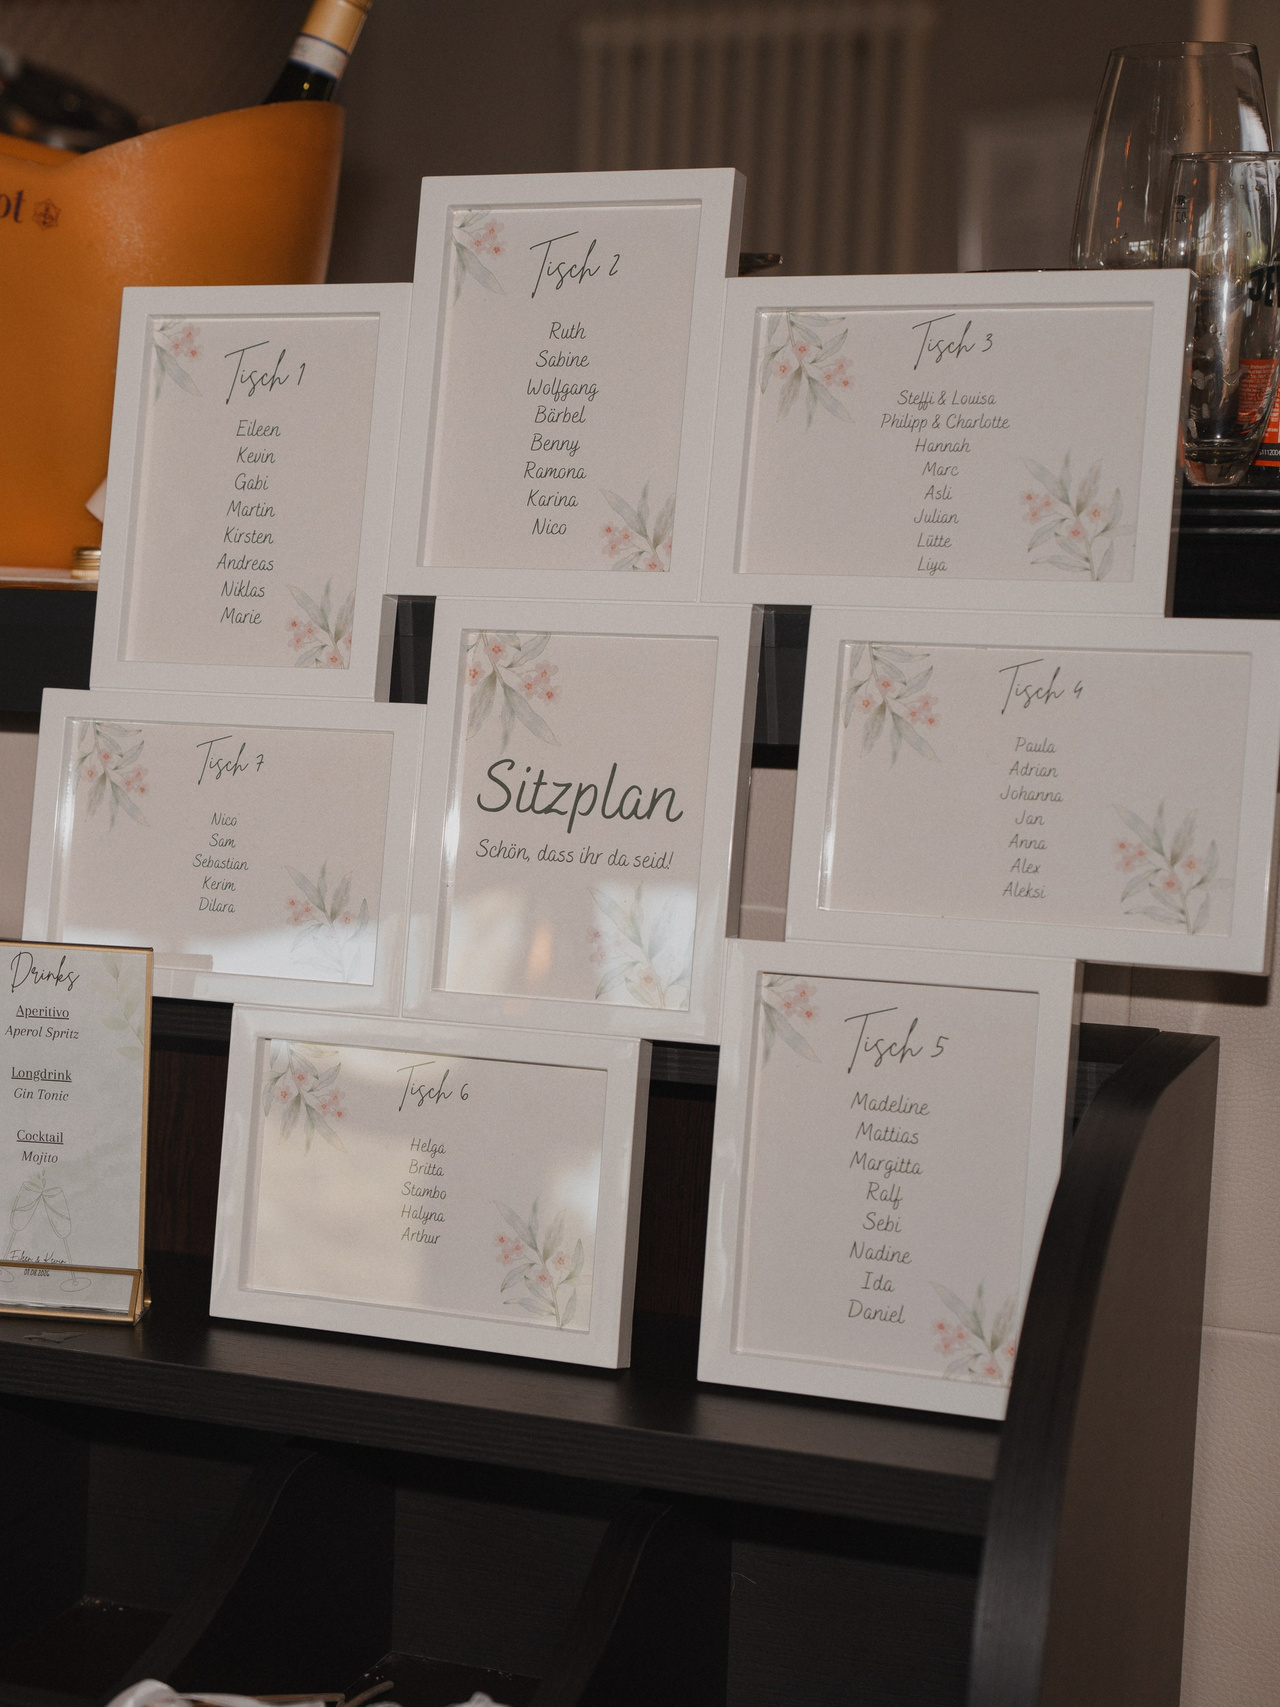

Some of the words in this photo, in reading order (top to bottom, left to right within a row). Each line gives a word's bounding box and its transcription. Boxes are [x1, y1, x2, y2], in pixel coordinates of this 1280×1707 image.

[529, 231, 601, 299] Tisch
[608, 254, 620, 276] 2
[549, 321, 586, 340] Ruth
[912, 313, 976, 371] Tisch
[981, 333, 993, 352] 3
[535, 349, 590, 368] Sabine
[224, 340, 290, 405] Tisch
[297, 362, 306, 386] 1
[527, 377, 599, 402] Wolfgang
[897, 389, 935, 411] Steffi
[937, 390, 946, 405] &
[951, 390, 997, 405] Louisa
[534, 405, 586, 423] Bärbel
[880, 413, 928, 433] Philipp
[931, 414, 941, 429] &
[946, 413, 1011, 429] Charlotte
[236, 419, 281, 437] Eileen
[530, 433, 580, 457] Benny
[915, 437, 971, 453] Hannah
[236, 446, 276, 464] Kevin
[523, 461, 587, 479] Ramona
[921, 461, 959, 476] Marc
[234, 472, 269, 491] Gabi
[527, 489, 579, 507] Karina
[924, 484, 953, 500] Asli
[226, 500, 275, 517] Martin
[913, 508, 959, 524] Julian
[223, 526, 274, 544] Kirsten
[532, 518, 567, 535] Nico
[917, 532, 952, 548] Lütte
[216, 553, 274, 571] Andreas
[917, 556, 948, 576] Liya
[221, 579, 265, 598] Niklas
[220, 606, 262, 625] Marie
[998, 658, 1065, 715] Tisch
[1073, 680, 1084, 699] 4
[1014, 736, 1057, 753] Paula
[196, 735, 249, 785] Tisch
[256, 754, 264, 772] 7
[1008, 760, 1059, 778] Adrian
[477, 758, 683, 833] Sitzplan
[999, 785, 1064, 802] Johanna
[211, 812, 238, 826] Nico
[1015, 809, 1045, 826] Jan
[209, 833, 236, 848] Sam
[1008, 833, 1048, 850] Anna
[192, 853, 249, 871] Sebastian
[475, 838, 530, 862] Schön,
[537, 844, 574, 863] dass
[579, 845, 603, 865] ihr
[607, 848, 630, 867] da
[633, 851, 674, 870] seid!
[1009, 857, 1041, 874] Alex
[202, 875, 236, 892] Kerim
[1002, 881, 1046, 899] Aleksi
[198, 897, 236, 913] Dilara
[10, 951, 80, 993] Drinks
[16, 1005, 70, 1020] Aperitivo
[5, 1025, 43, 1039] Aperol
[45, 1027, 79, 1041] Spritz
[844, 1007, 924, 1074] Tisch
[930, 1035, 949, 1058] 5
[11, 1067, 72, 1083] Longdrink
[14, 1087, 34, 1099] Gin
[38, 1089, 69, 1101] Tonic
[397, 1061, 453, 1112] Tisch
[460, 1083, 469, 1101] 6
[850, 1091, 930, 1116] Madeline
[16, 1129, 64, 1145] Cocktail
[855, 1121, 919, 1145] Mattias
[410, 1137, 447, 1159] Helga
[21, 1150, 58, 1165] Mojito
[849, 1150, 924, 1179] Margitta
[409, 1159, 445, 1177] Britta
[401, 1181, 447, 1200] Stambo
[866, 1181, 903, 1210] Ralf
[401, 1204, 446, 1225] Halyna
[862, 1211, 902, 1233] Sebi
[401, 1227, 441, 1244] Arthur
[849, 1240, 912, 1265] Nadine
[860, 1271, 895, 1293] Ida
[848, 1299, 906, 1324] Daniel
